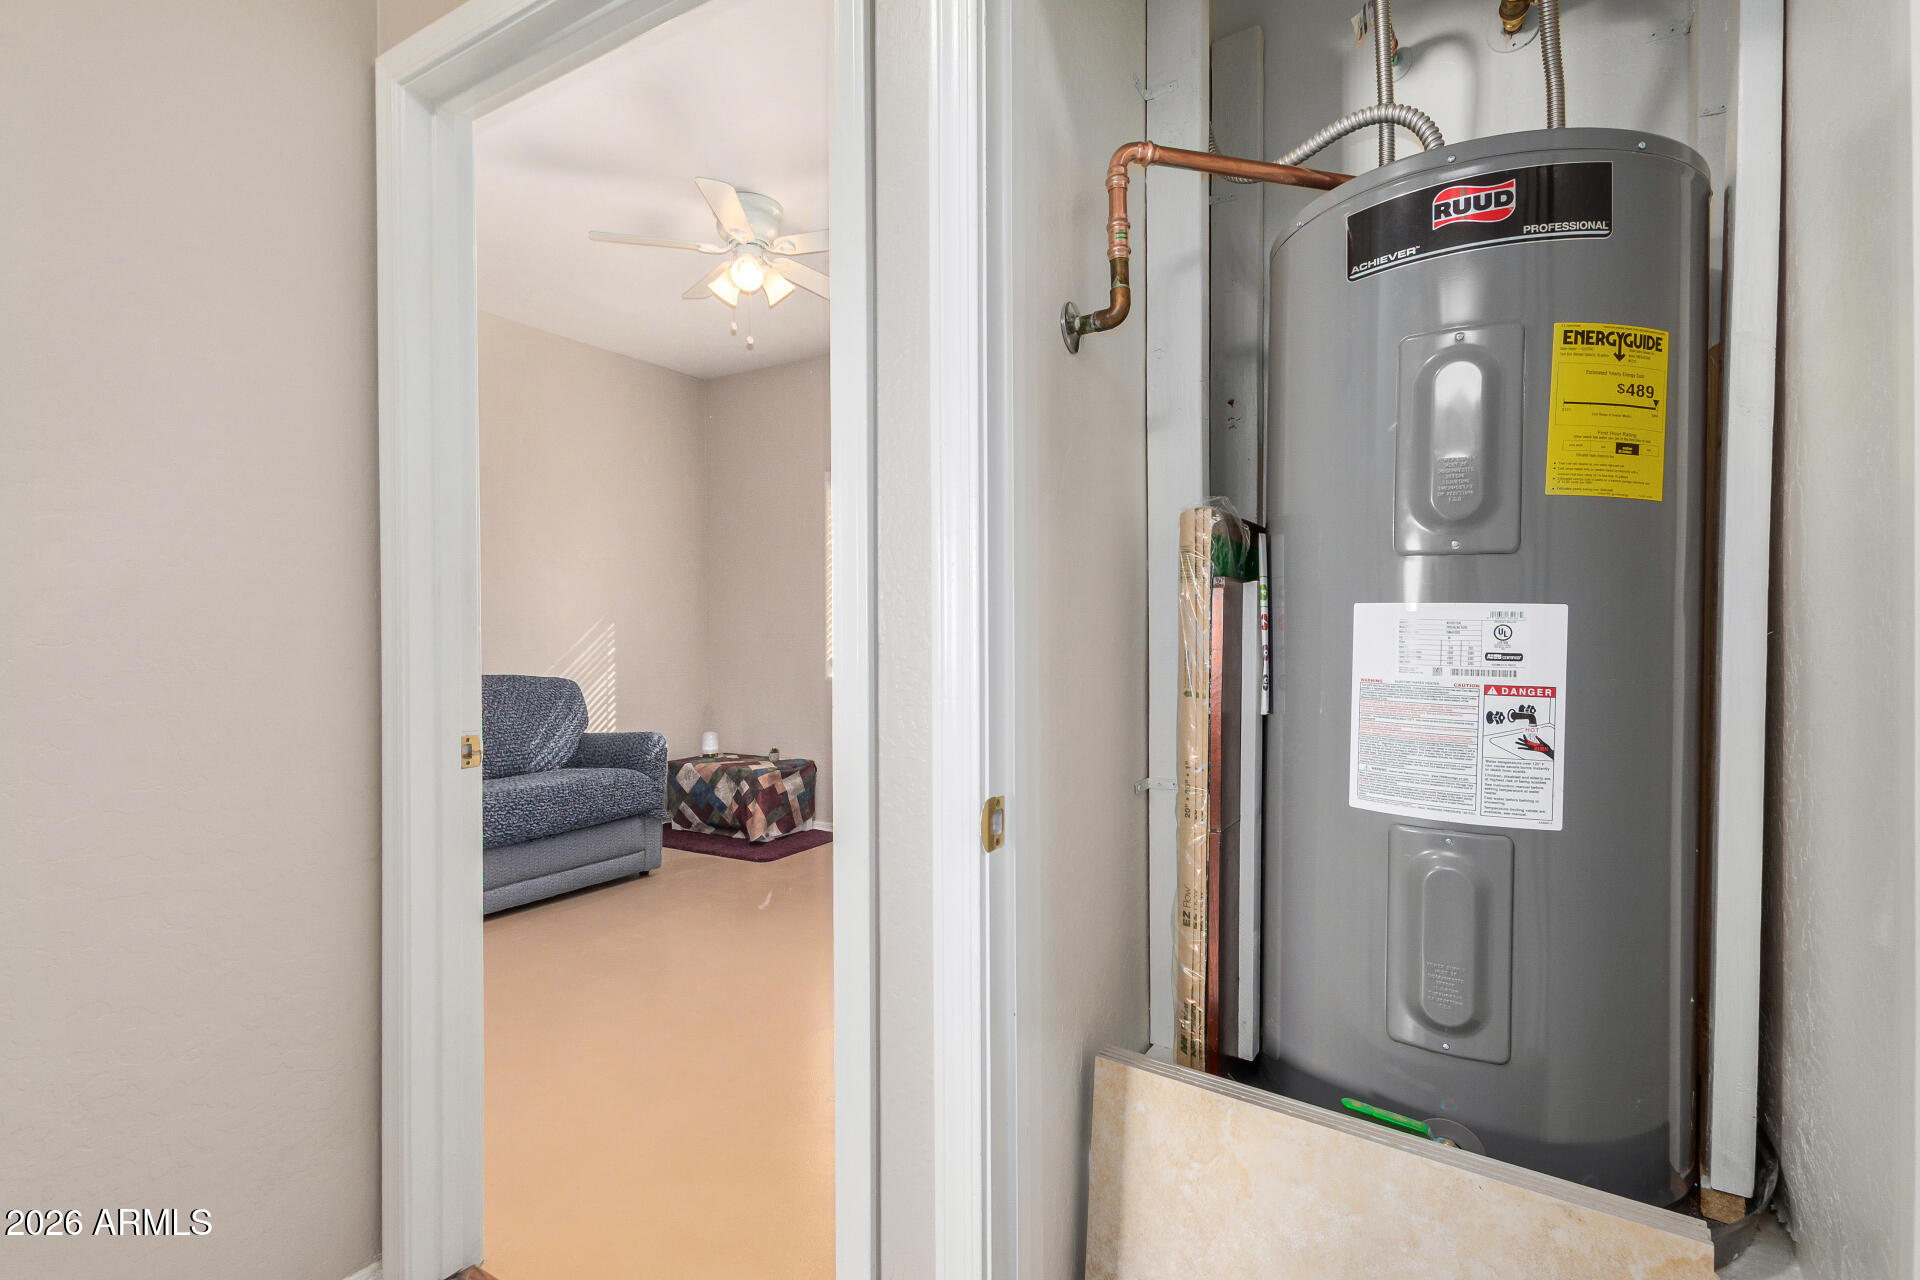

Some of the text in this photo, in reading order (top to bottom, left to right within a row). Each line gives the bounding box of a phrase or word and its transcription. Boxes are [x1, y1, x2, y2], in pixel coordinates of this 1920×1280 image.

[1434, 189, 1514, 220] RUUD
[1523, 221, 1609, 234] PROFESSIONAL
[1562, 330, 1662, 353] ENERGYGUIDE
[1617, 384, 1654, 398] $489
[1498, 628, 1508, 638] UL
[1501, 687, 1552, 696] DANGER
[1183, 886, 1191, 927] EZ Flow
